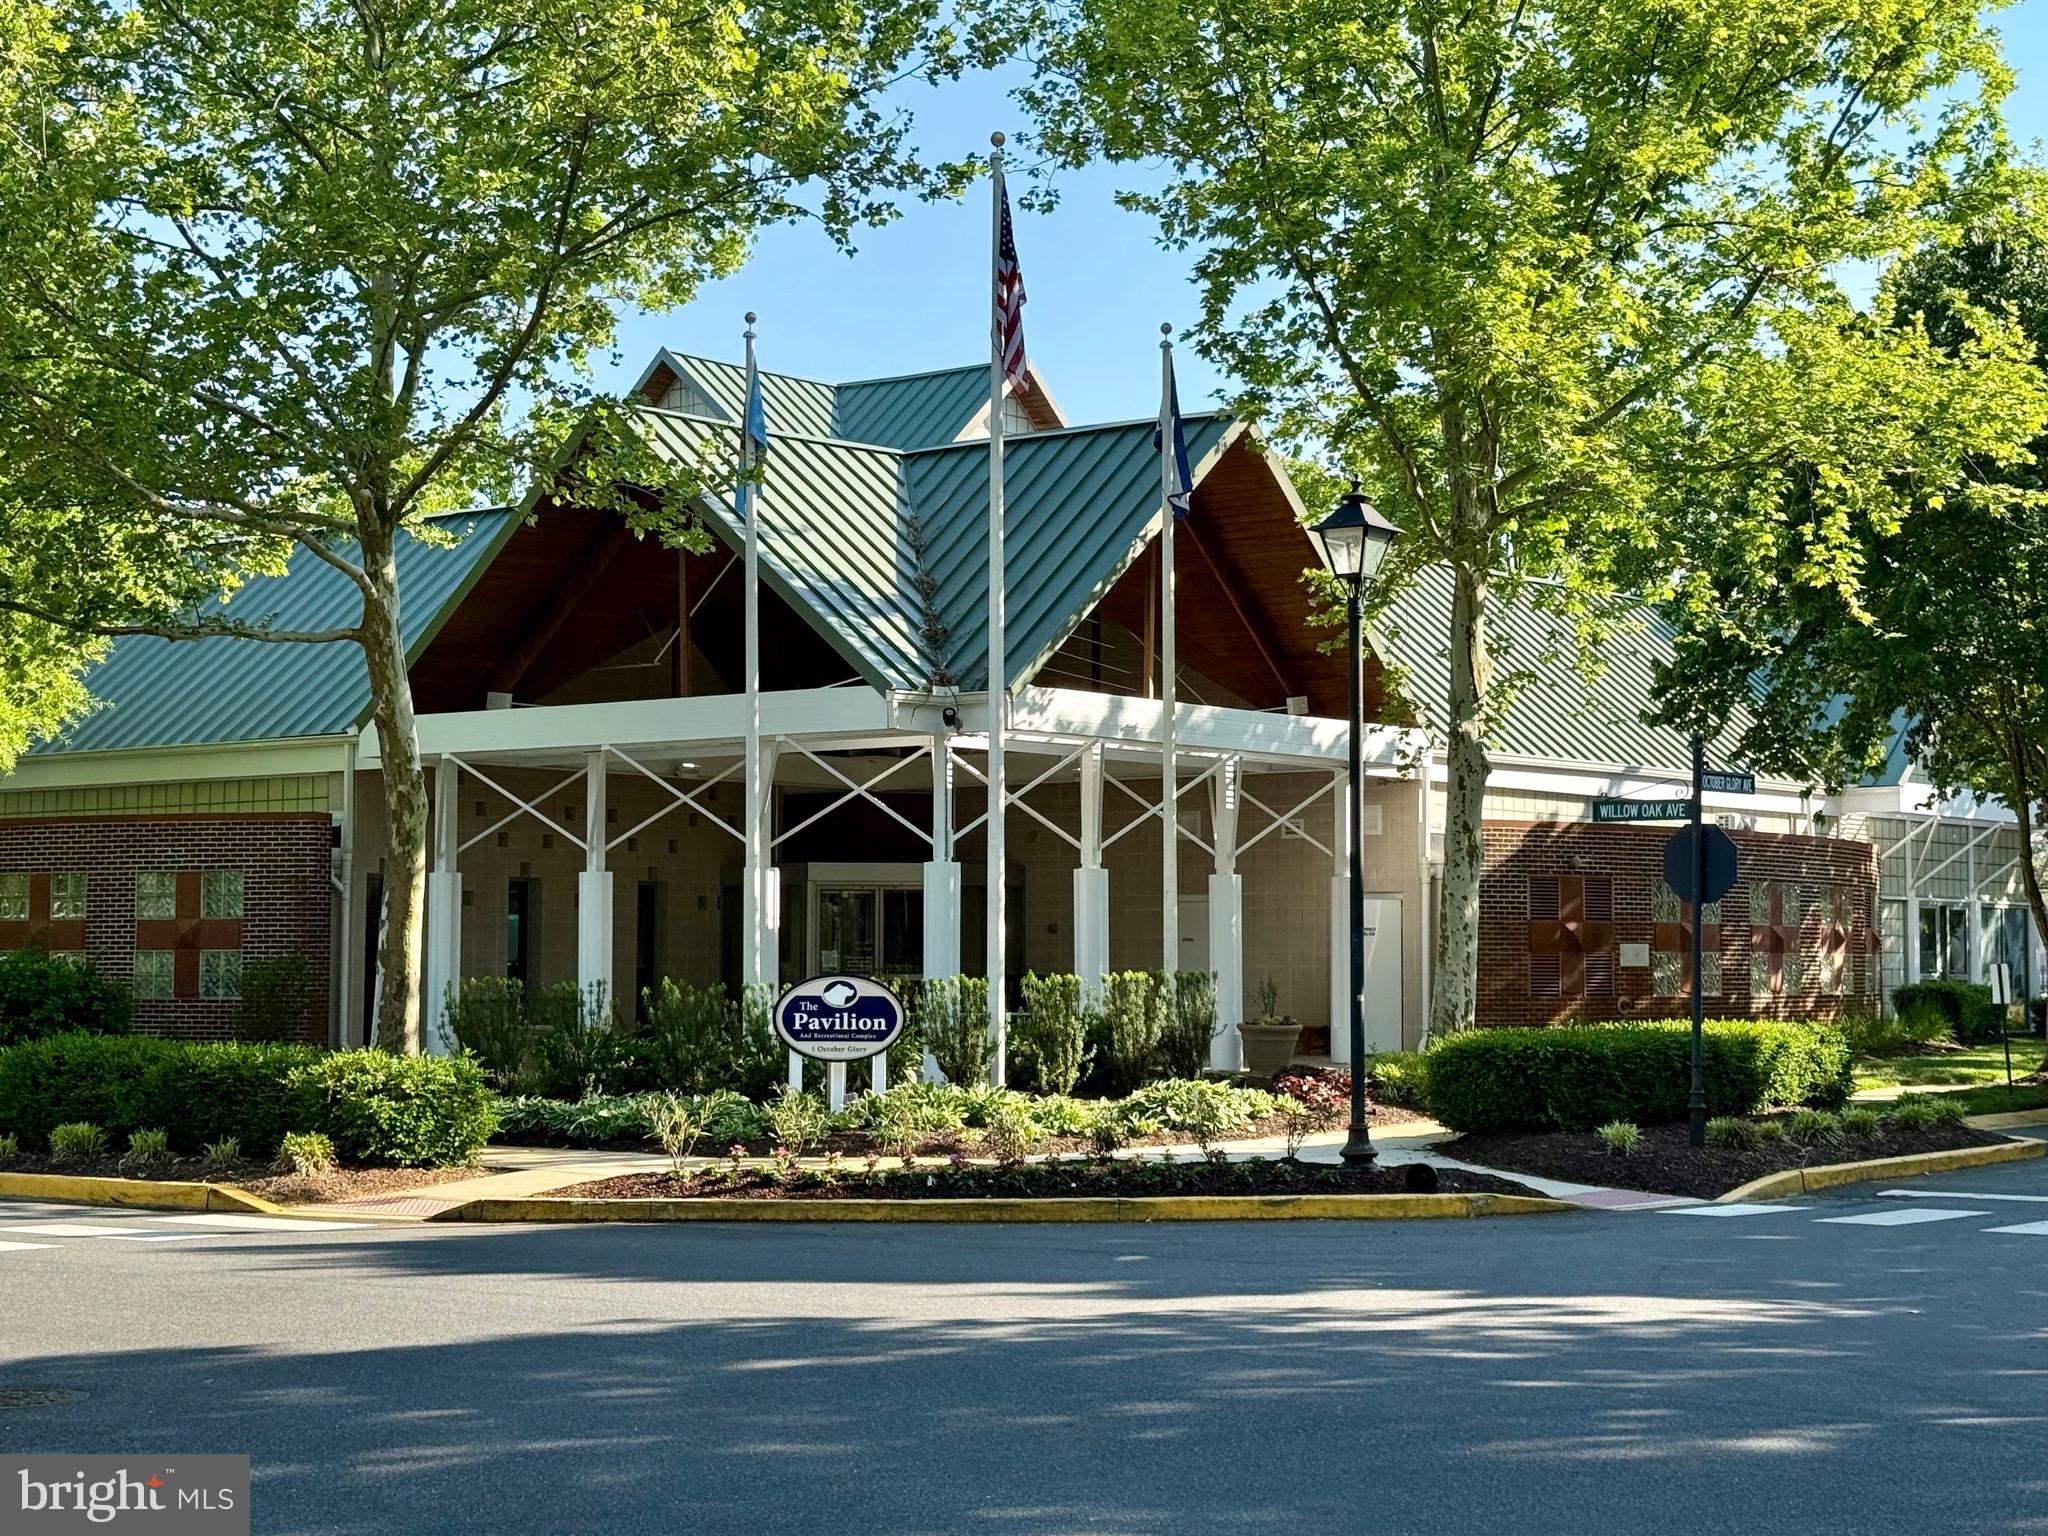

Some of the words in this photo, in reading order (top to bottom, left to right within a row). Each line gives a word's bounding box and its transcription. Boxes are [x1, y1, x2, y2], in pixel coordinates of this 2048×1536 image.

[1702, 775, 1725, 790] OCTOBER
[1725, 777, 1742, 791] GLORY
[1743, 779, 1753, 792] AVE
[1600, 804, 1638, 818] WILLOW
[1642, 803, 1663, 817] OAK
[1666, 803, 1686, 817] AVE
[799, 1001, 818, 1011] The
[793, 1012, 887, 1031] Pavilion
[847, 1045, 867, 1053] Glory
